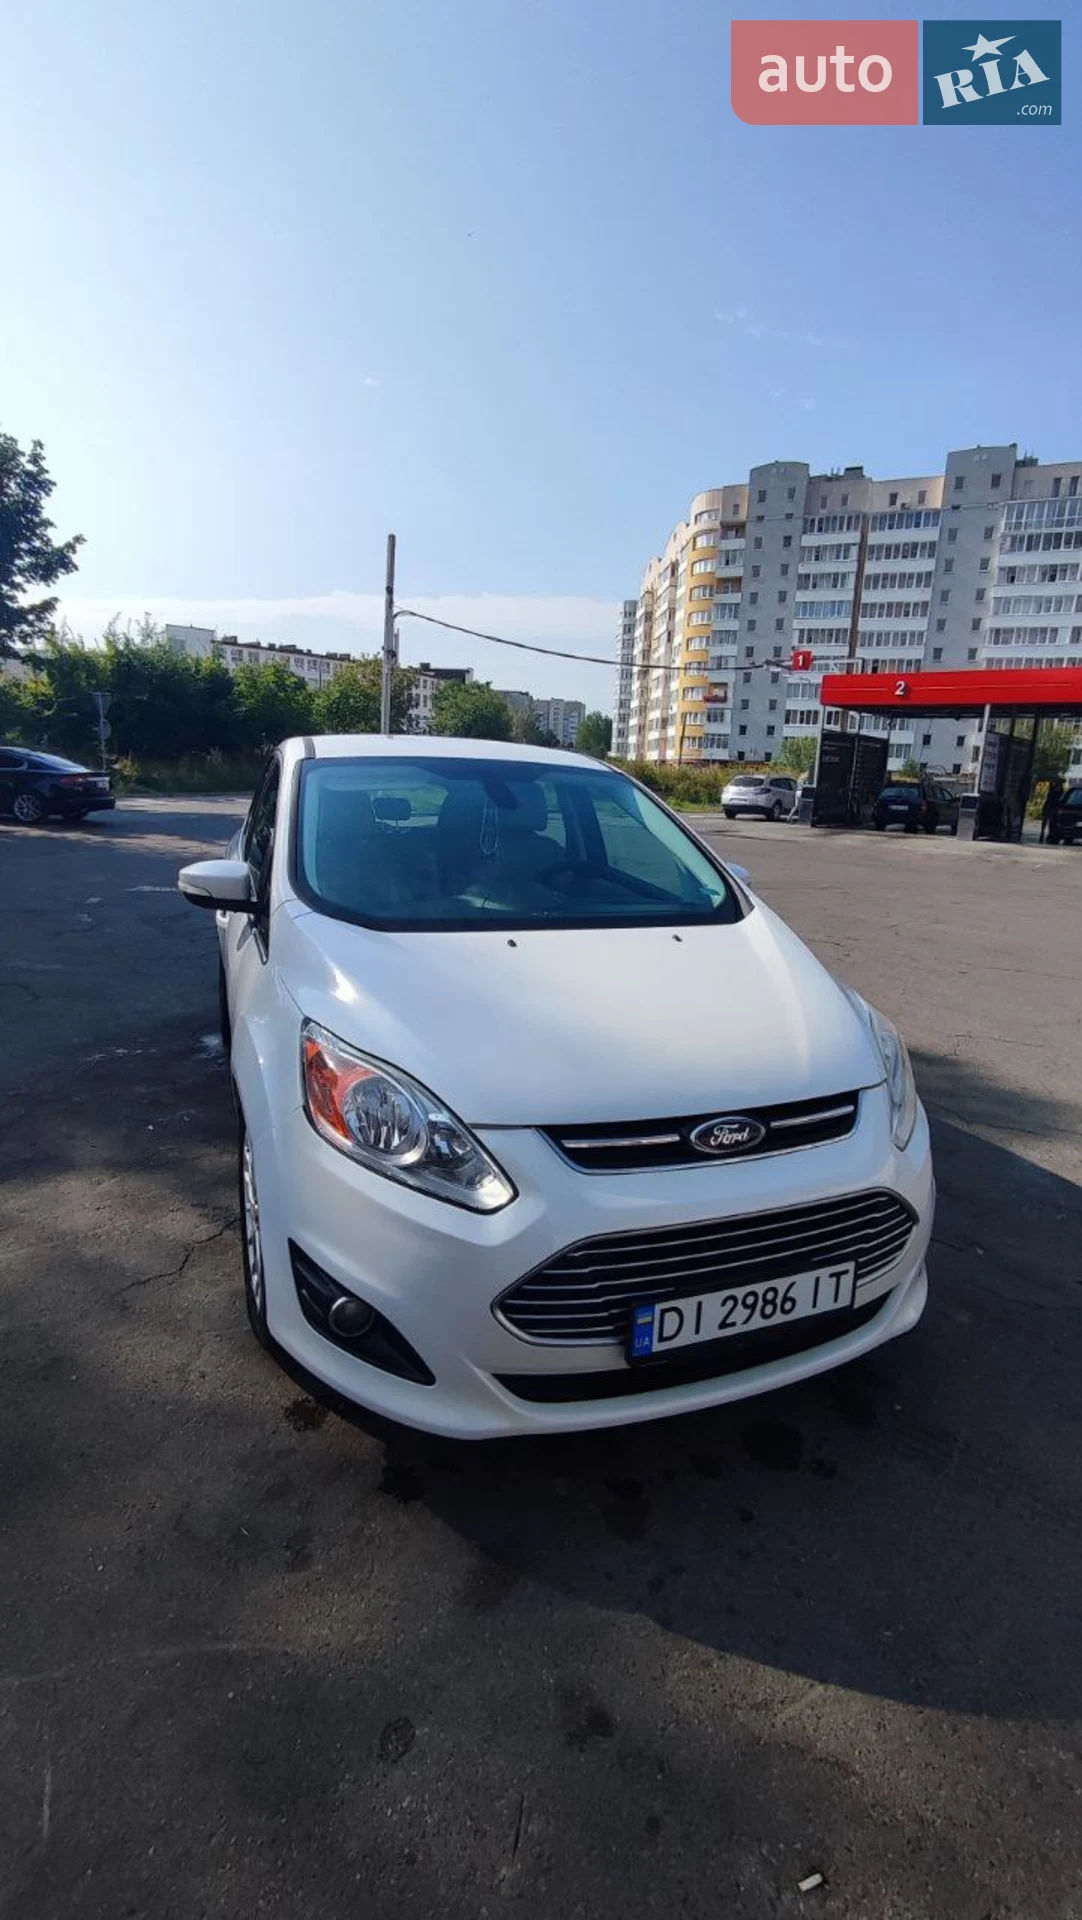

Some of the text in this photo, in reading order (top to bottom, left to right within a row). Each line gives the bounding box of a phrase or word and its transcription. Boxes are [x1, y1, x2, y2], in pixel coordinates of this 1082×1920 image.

[797, 655, 804, 667] 1
[894, 680, 906, 696] 2
[709, 1123, 750, 1147] Ford
[657, 1268, 850, 1344] DI 2986 IT
[635, 1336, 651, 1349] UA
